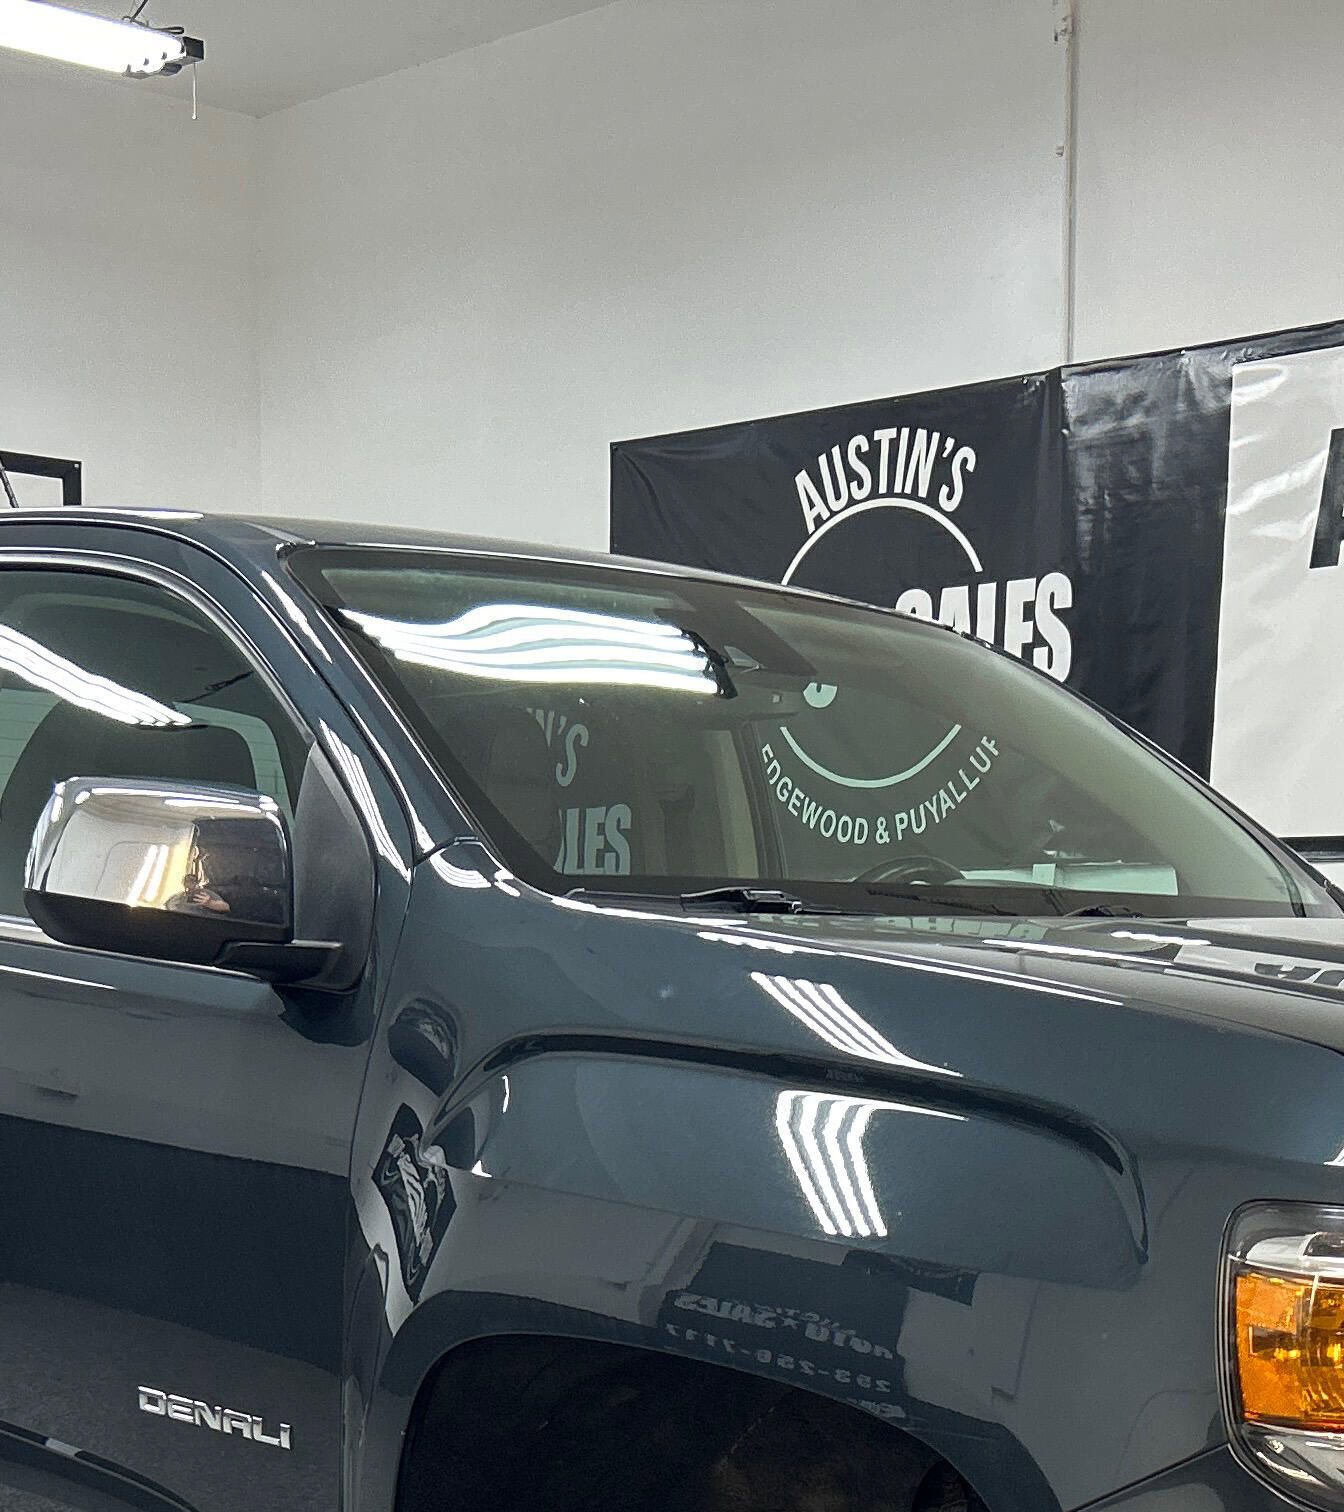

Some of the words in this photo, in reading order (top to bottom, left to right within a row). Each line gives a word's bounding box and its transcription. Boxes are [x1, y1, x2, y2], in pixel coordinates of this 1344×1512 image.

[794, 427, 976, 535] AUSTIN'S
[761, 743, 869, 846] EDGEWOOD
[875, 817, 891, 845] &
[137, 1385, 291, 1450] DENALI
